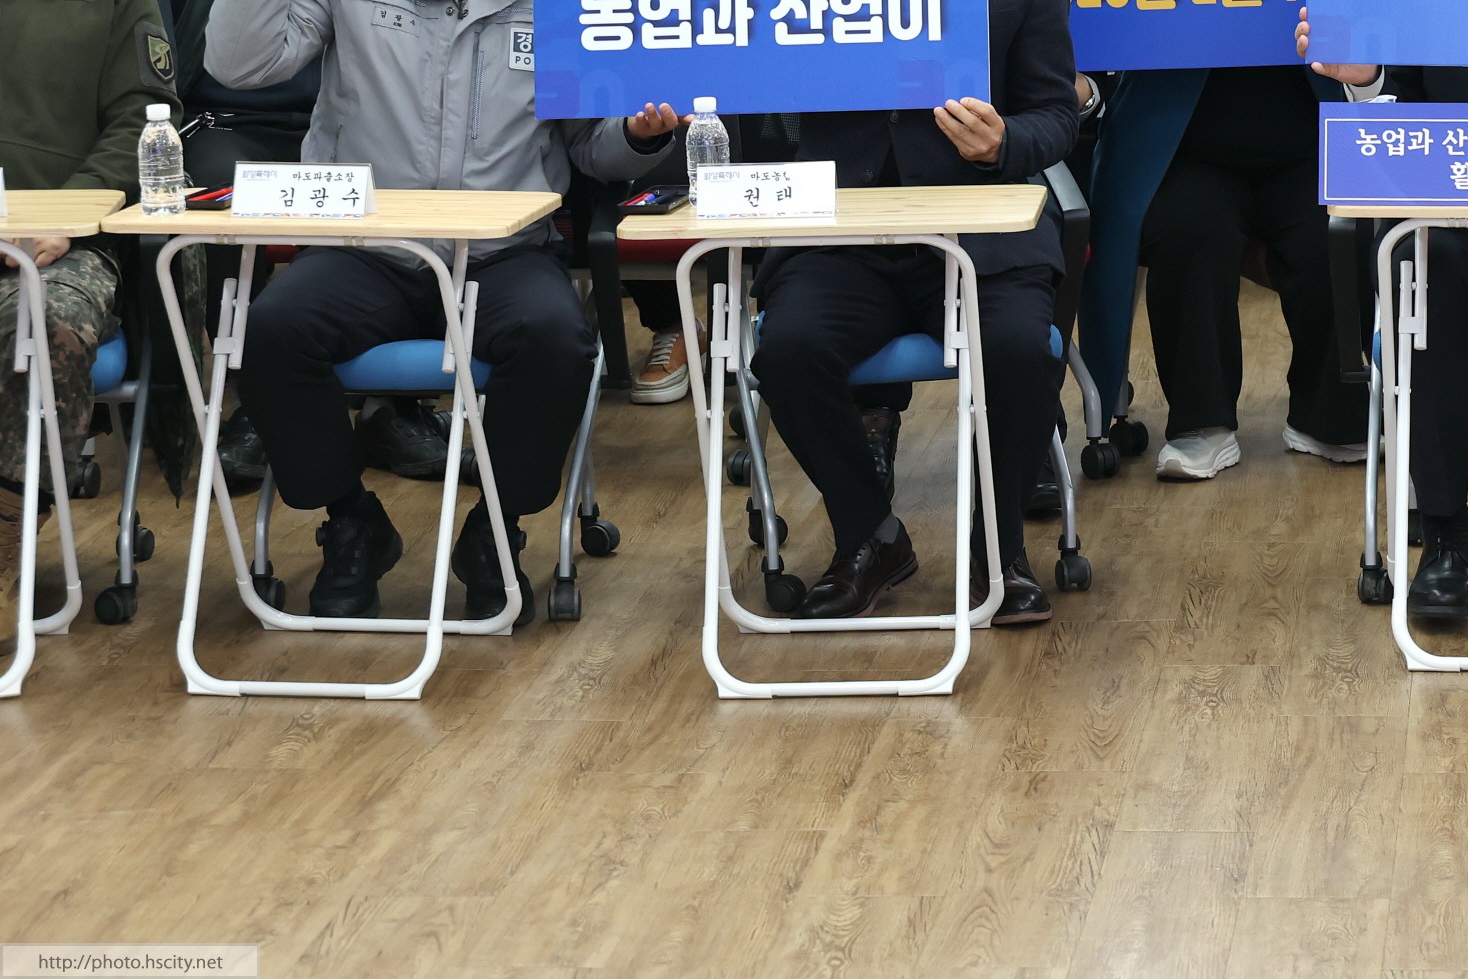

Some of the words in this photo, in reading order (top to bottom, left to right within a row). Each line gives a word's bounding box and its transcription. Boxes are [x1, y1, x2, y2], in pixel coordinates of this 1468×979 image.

[517, 33, 533, 52] 경
[515, 56, 532, 65] PO
[1355, 128, 1434, 157] 농업과
[292, 172, 354, 182] 마도파출소장
